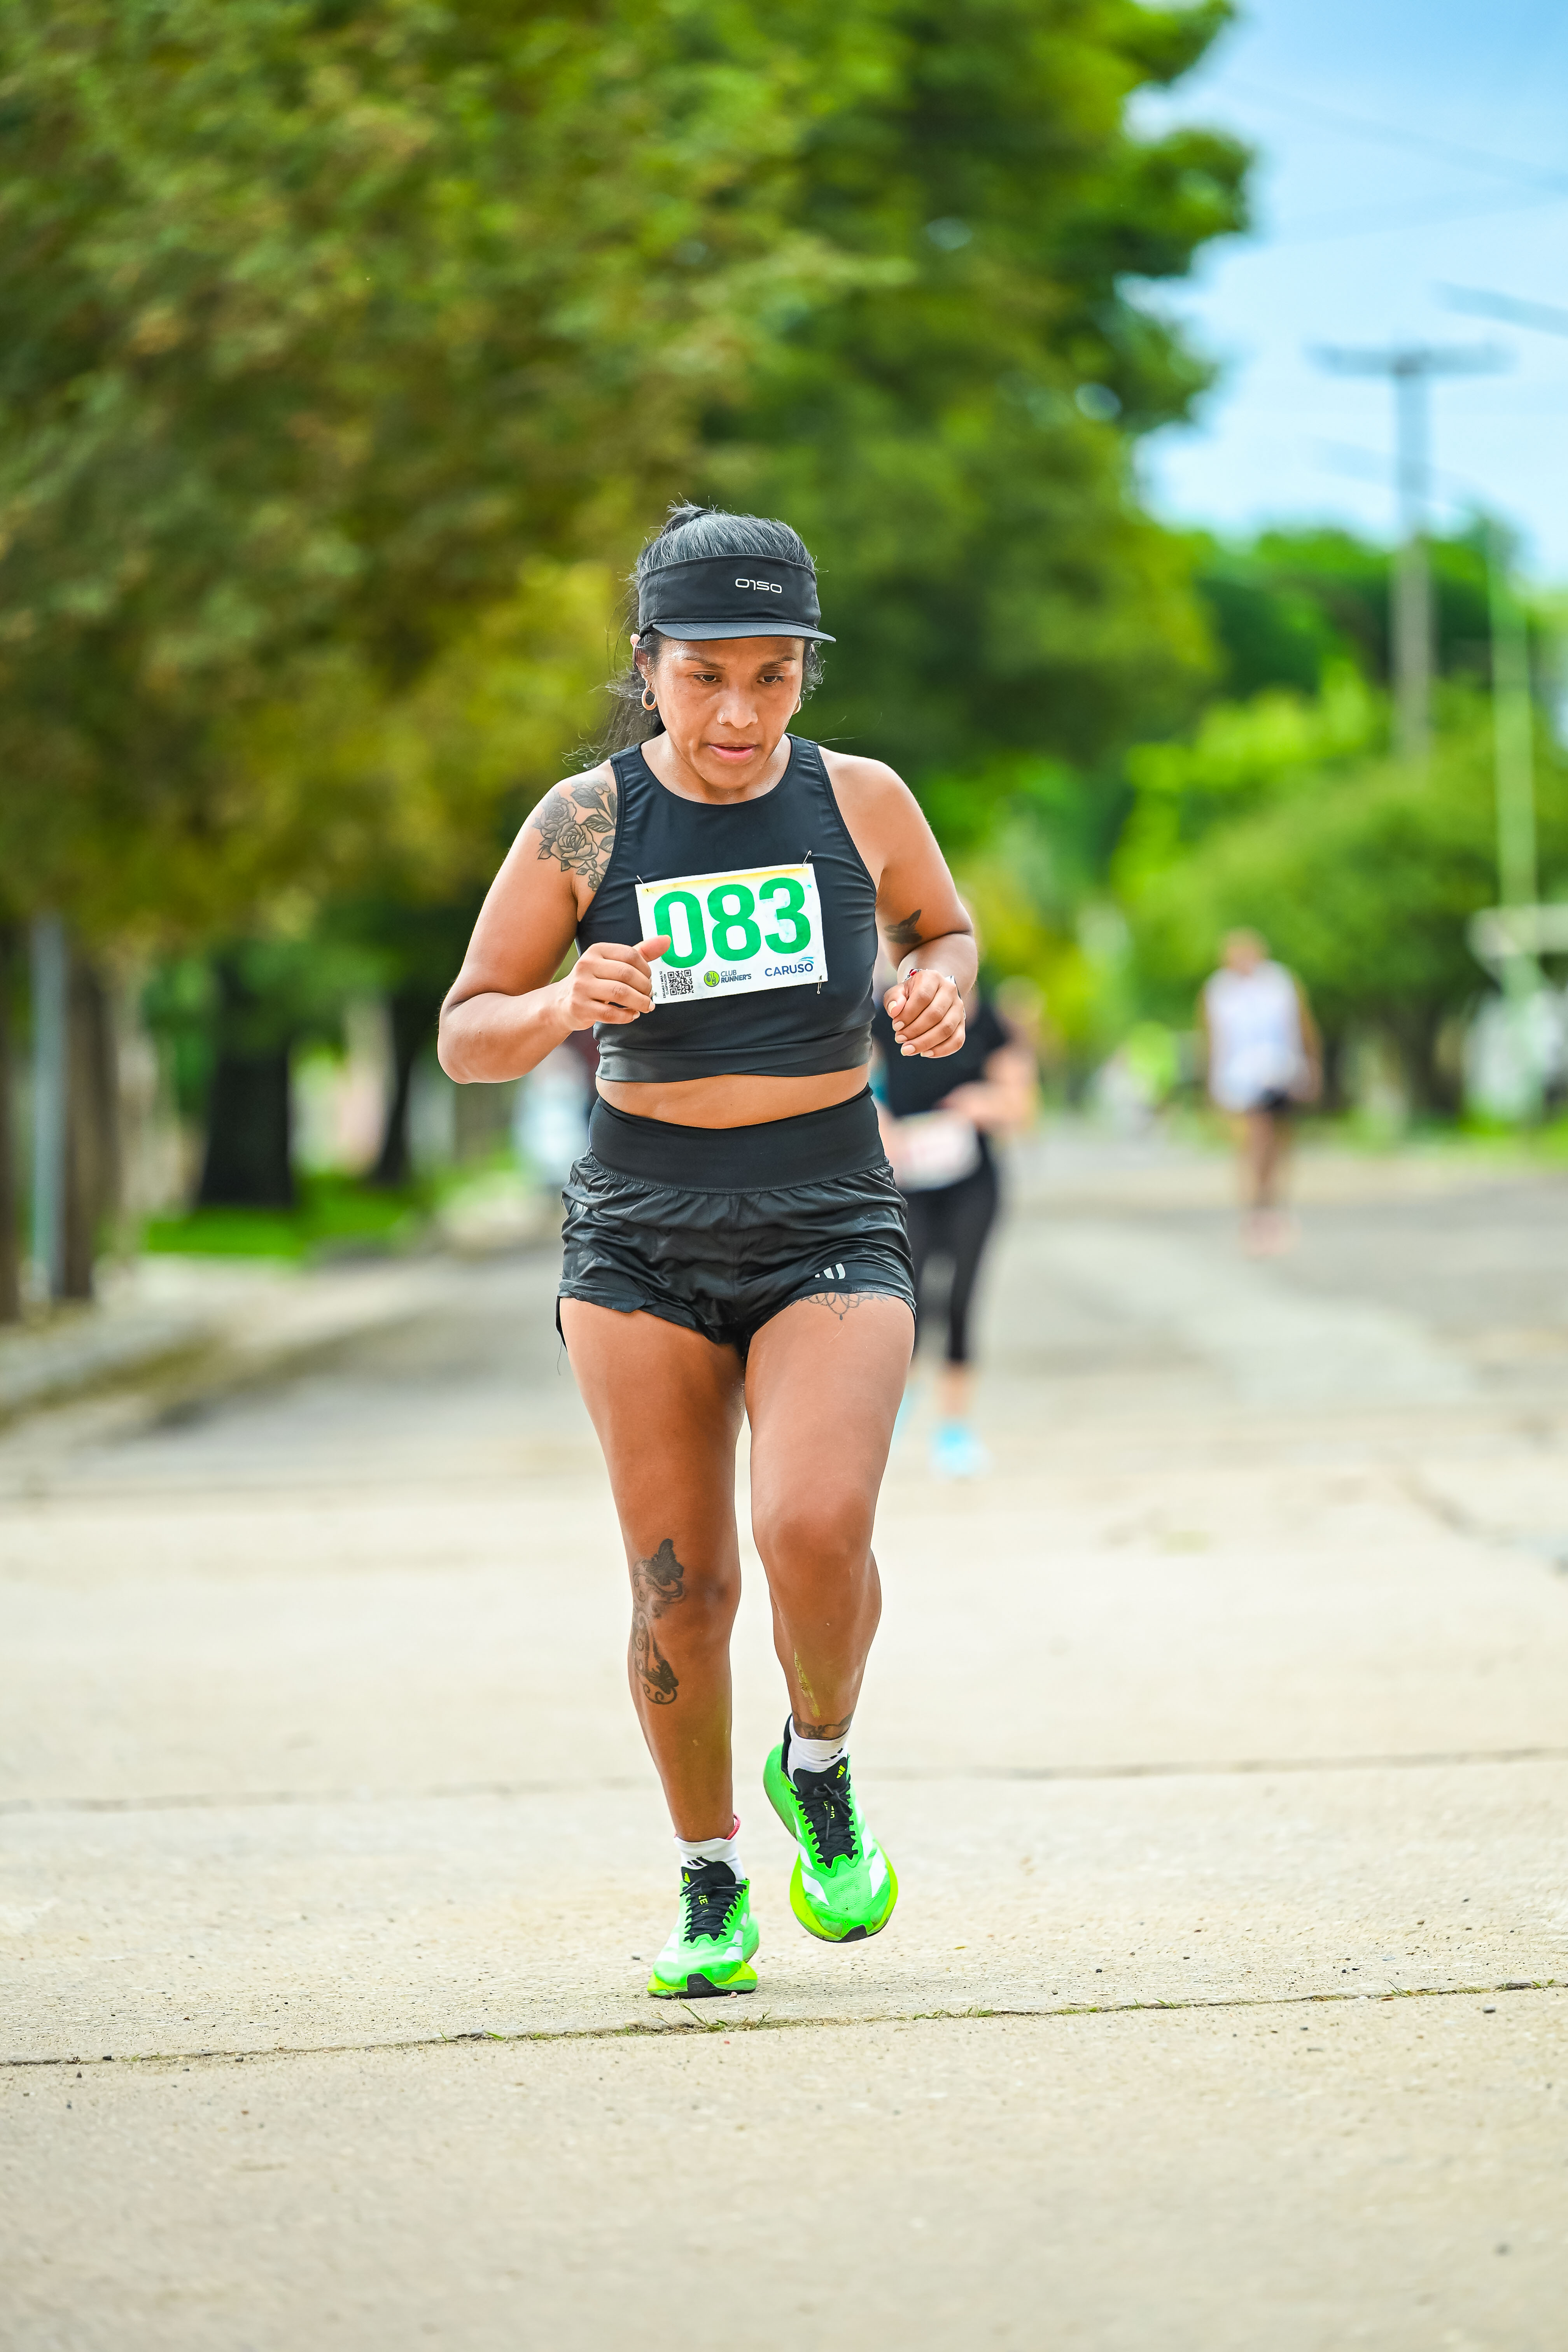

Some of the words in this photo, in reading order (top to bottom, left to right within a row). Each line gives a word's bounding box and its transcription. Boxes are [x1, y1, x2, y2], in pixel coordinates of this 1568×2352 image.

[654, 878, 811, 968] 083
[765, 963, 813, 977] CARUSO
[721, 973, 752, 983] RUNNER'S
